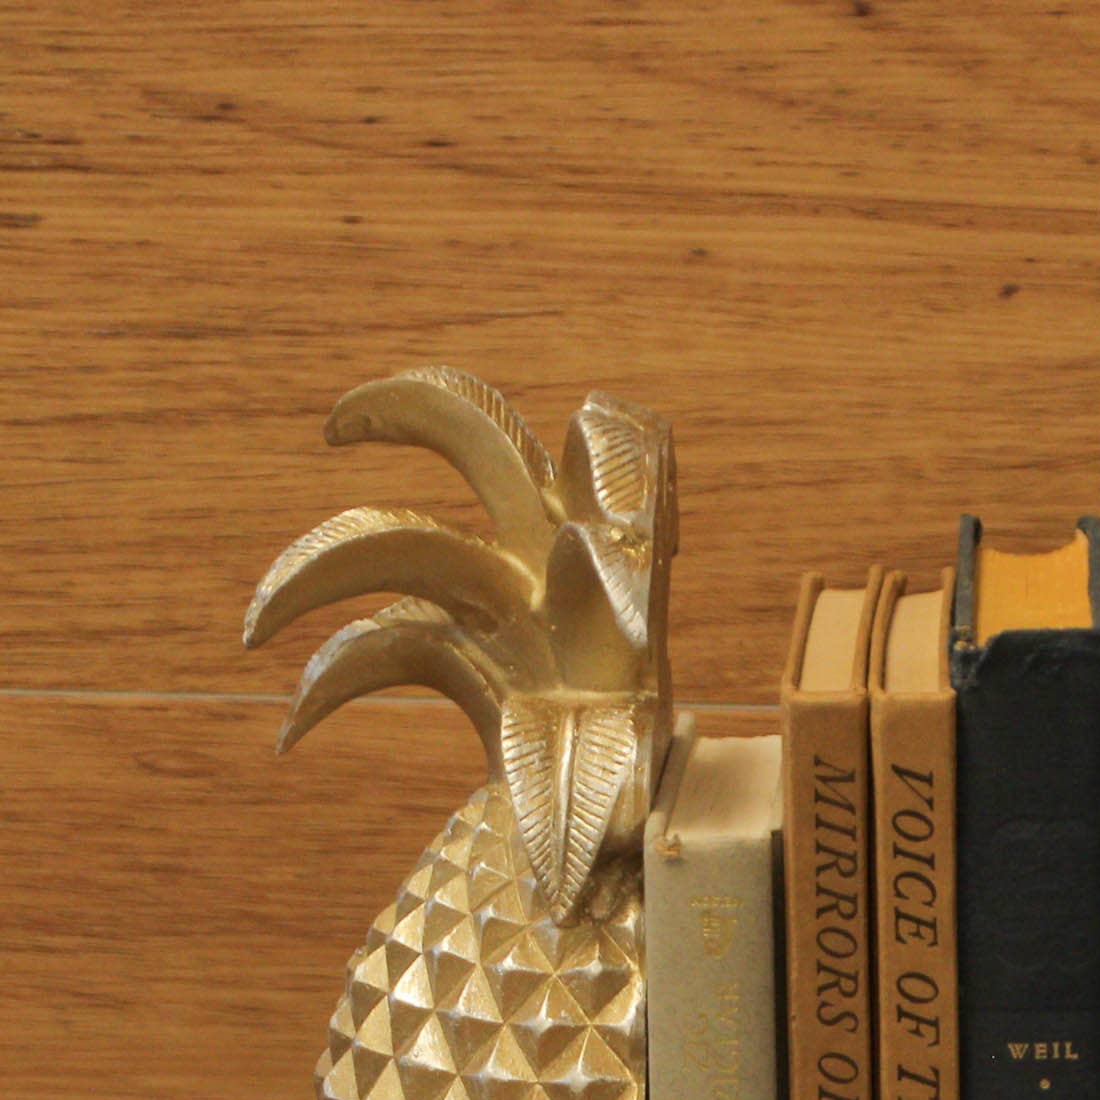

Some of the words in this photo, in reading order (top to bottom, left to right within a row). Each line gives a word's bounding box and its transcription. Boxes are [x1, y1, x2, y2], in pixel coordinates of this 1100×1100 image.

[813, 754, 860, 1034] MIRRORS
[890, 763, 940, 948] VOICE
[895, 971, 941, 1048] OF
[1007, 1042, 1079, 1060] WEIL
